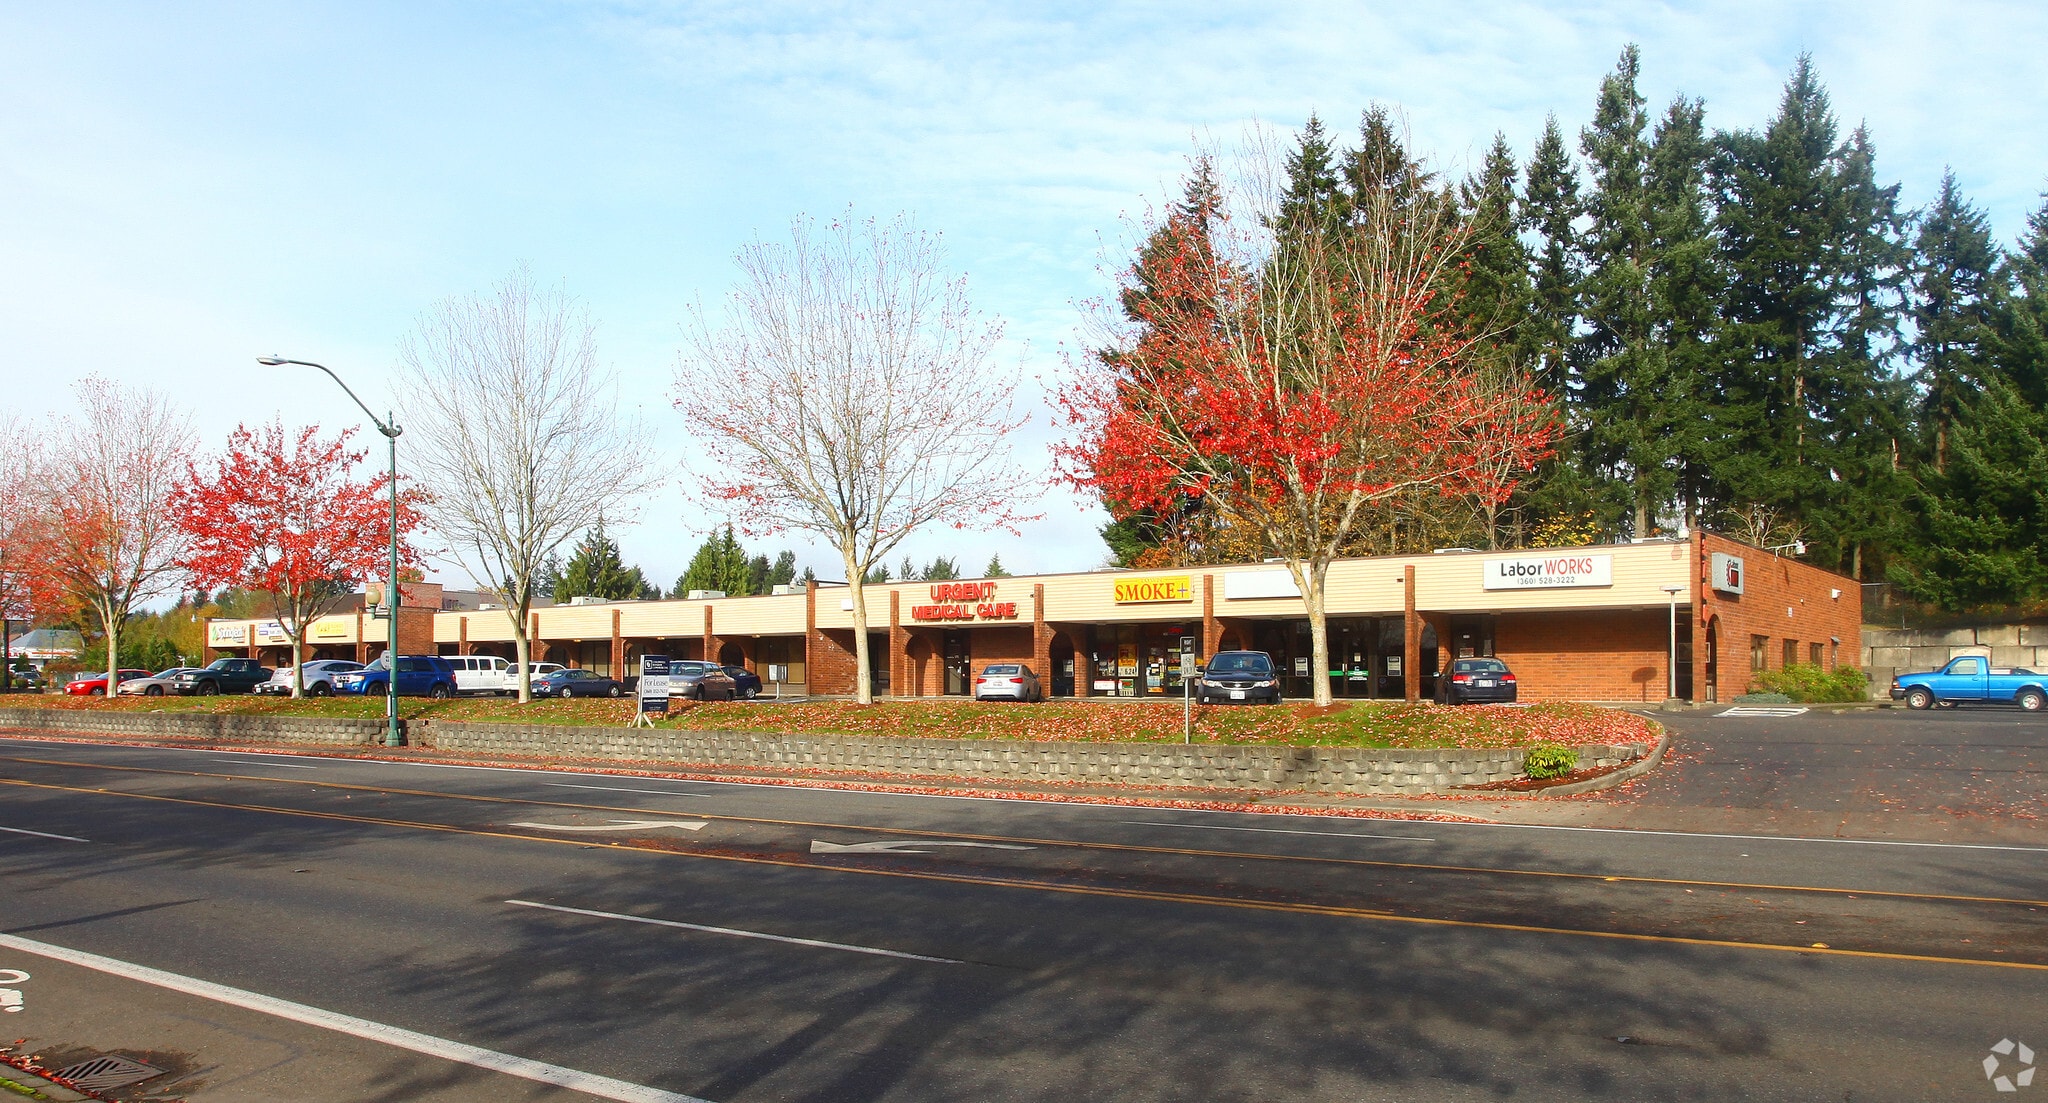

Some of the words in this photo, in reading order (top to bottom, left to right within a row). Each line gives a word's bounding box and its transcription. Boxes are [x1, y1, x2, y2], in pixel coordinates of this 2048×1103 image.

[1517, 577, 1537, 585] (360)
[1539, 576, 1575, 584] 528-3222
[930, 582, 996, 602] URGENT
[911, 603, 974, 620] MEDICAL
[976, 602, 1018, 618] CARE
[644, 679, 653, 687] For
[654, 679, 668, 687] Lease
